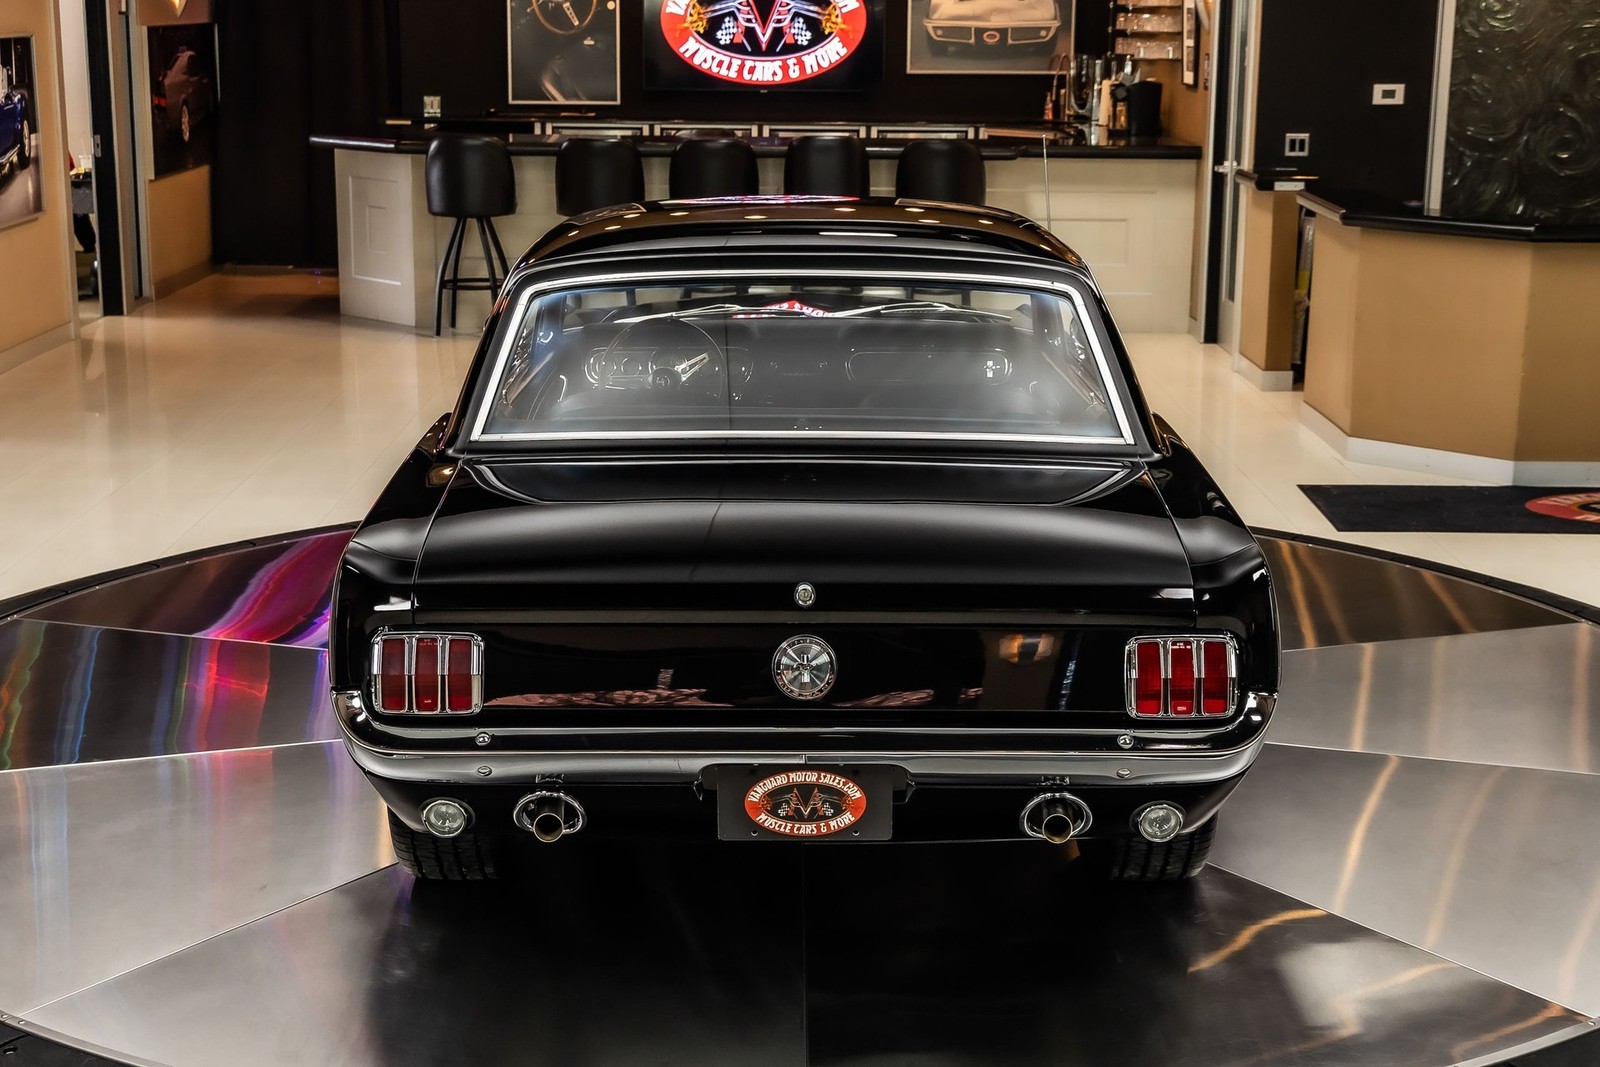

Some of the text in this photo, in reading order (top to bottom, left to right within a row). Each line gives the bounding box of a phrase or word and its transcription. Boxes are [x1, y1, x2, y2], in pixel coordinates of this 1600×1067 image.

[679, 36, 848, 82] MUSCLE CARS & MORE
[747, 771, 862, 802] VANGUARD MOTOR SALES.COM
[756, 811, 856, 835] MUSCLE CARS & MORE
